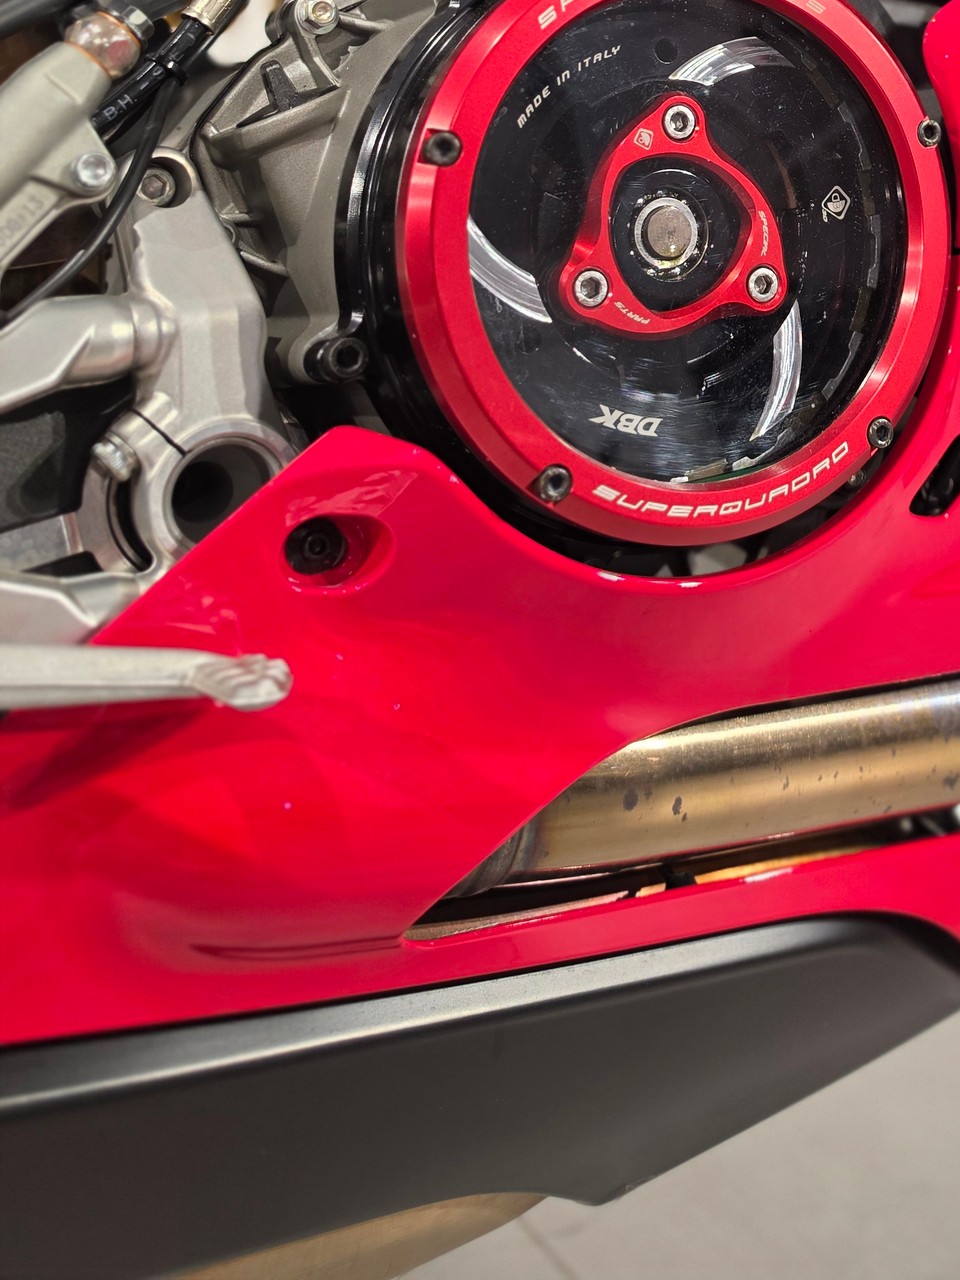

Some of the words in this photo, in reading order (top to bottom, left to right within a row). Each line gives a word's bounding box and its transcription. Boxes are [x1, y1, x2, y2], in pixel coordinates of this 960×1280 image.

[516, 85, 551, 129] MADE
[556, 70, 571, 86] IN
[577, 44, 621, 72] ITALY
[613, 301, 651, 325] PARTS
[588, 404, 664, 437] DBK
[592, 441, 849, 518] SUPERQUADRO
